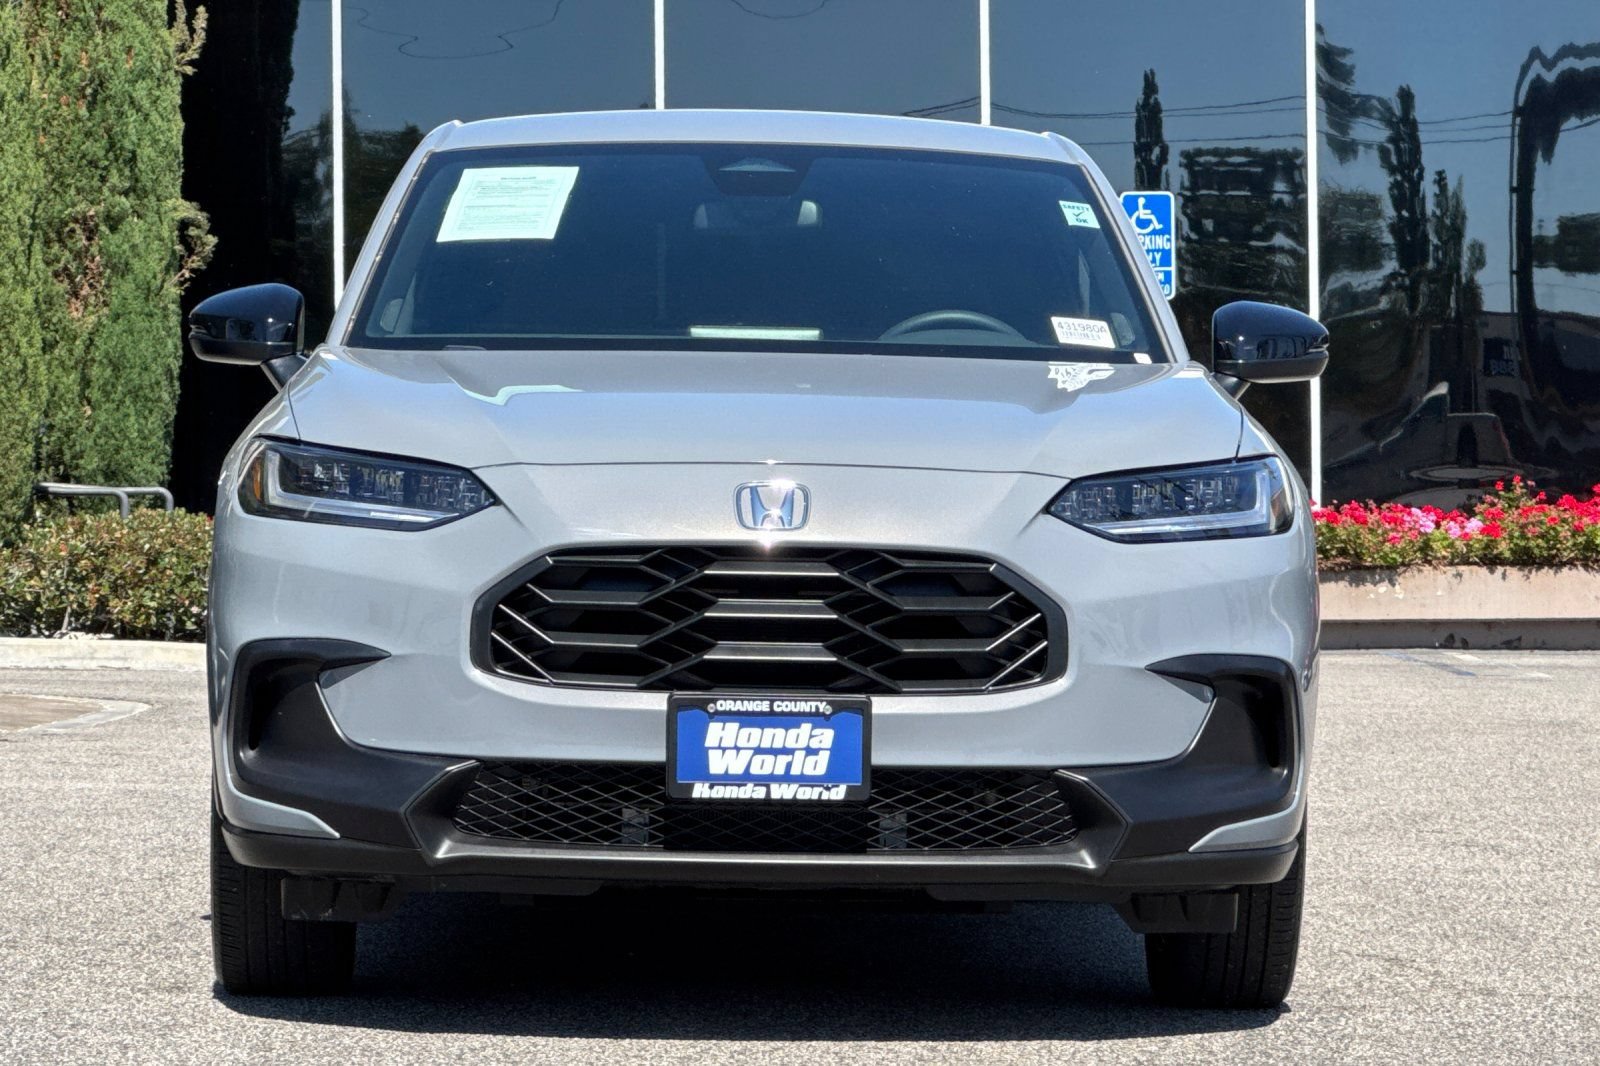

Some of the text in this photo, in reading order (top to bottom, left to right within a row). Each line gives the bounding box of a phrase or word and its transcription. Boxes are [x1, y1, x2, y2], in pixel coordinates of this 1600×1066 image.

[1137, 234, 1171, 250] RKING
[716, 700, 826, 713] ORANGE COUNTY
[704, 722, 835, 748] Honda
[707, 749, 831, 776] World
[691, 782, 767, 799] Honda
